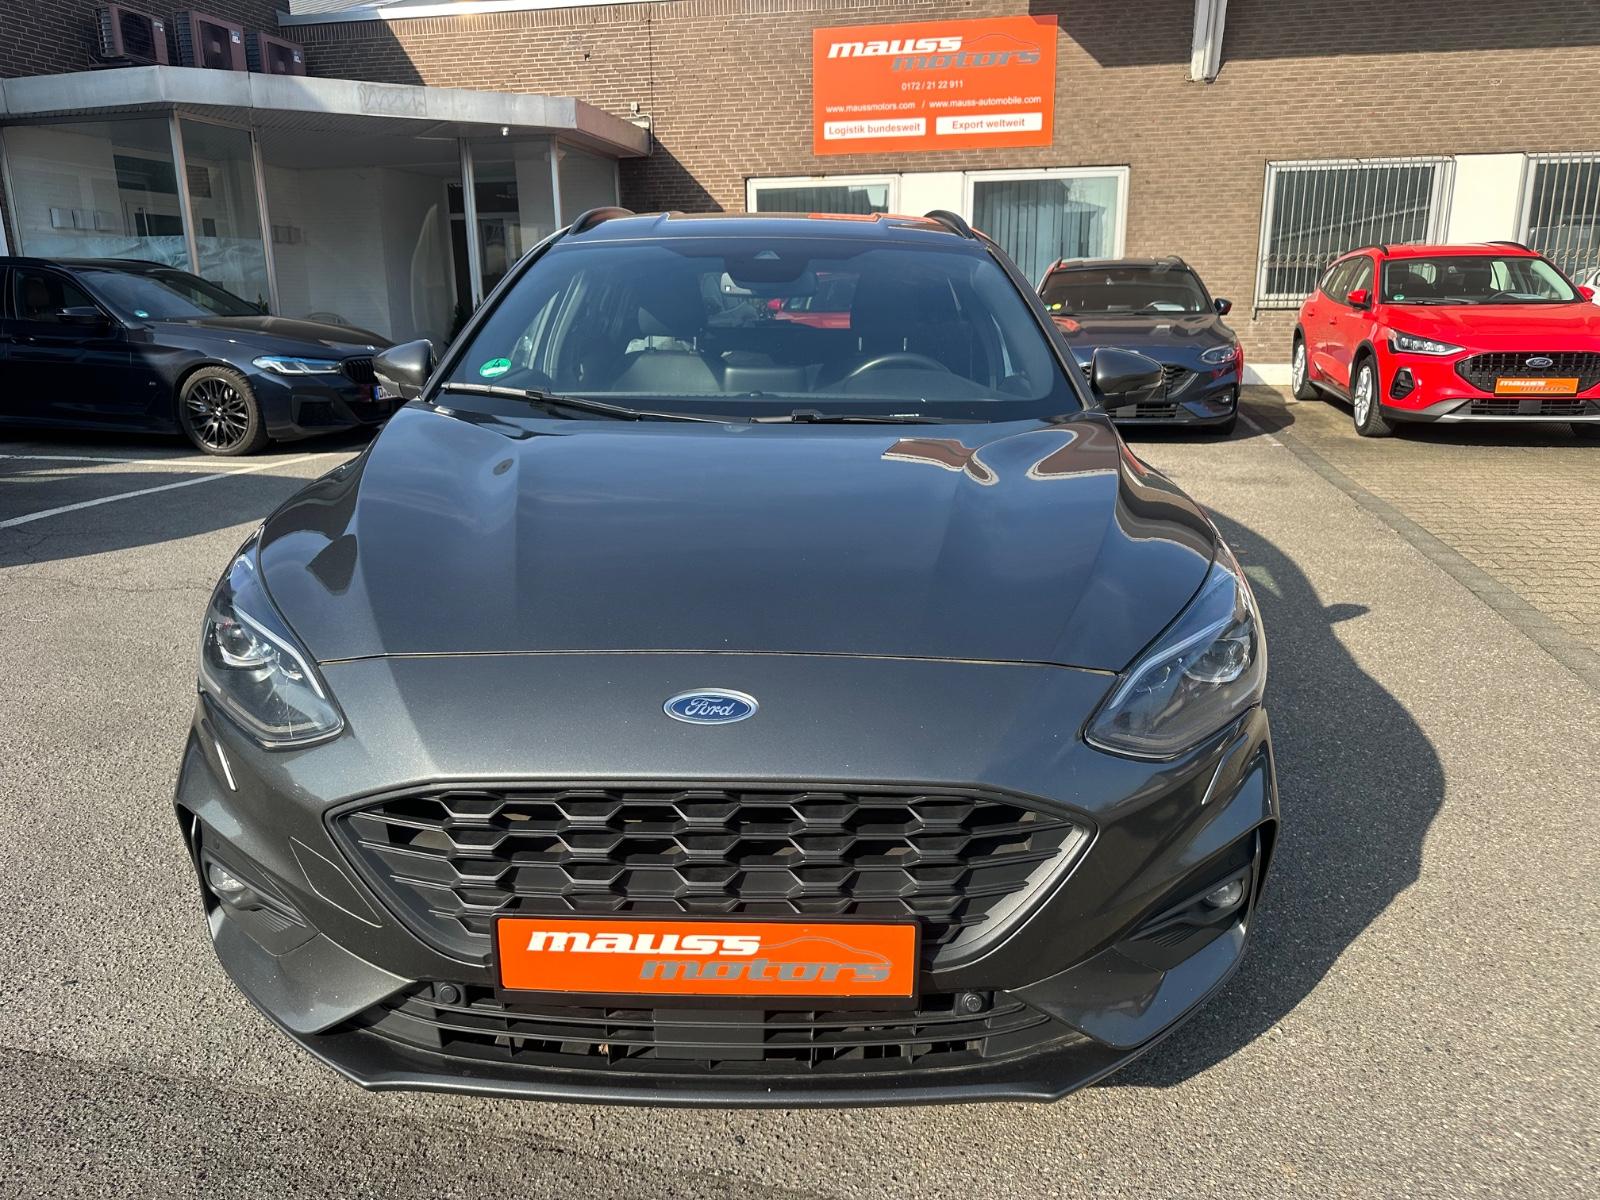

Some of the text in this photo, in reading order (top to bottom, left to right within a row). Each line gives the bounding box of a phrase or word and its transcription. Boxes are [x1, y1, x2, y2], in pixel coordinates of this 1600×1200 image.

[828, 36, 963, 58] mauss
[892, 49, 1041, 72] motors
[901, 81, 920, 91] 0172
[927, 81, 936, 90] 21
[938, 81, 947, 90] 22
[949, 80, 964, 89] 911
[826, 101, 915, 113] www.maussmotors.com
[929, 95, 1041, 108] www.mauss-automobile.com
[829, 122, 921, 135] Logistik bundesweit
[952, 118, 1025, 131] Export weltweit
[685, 698, 736, 716] Ford
[527, 931, 760, 955] mauss
[639, 959, 892, 983] motors
